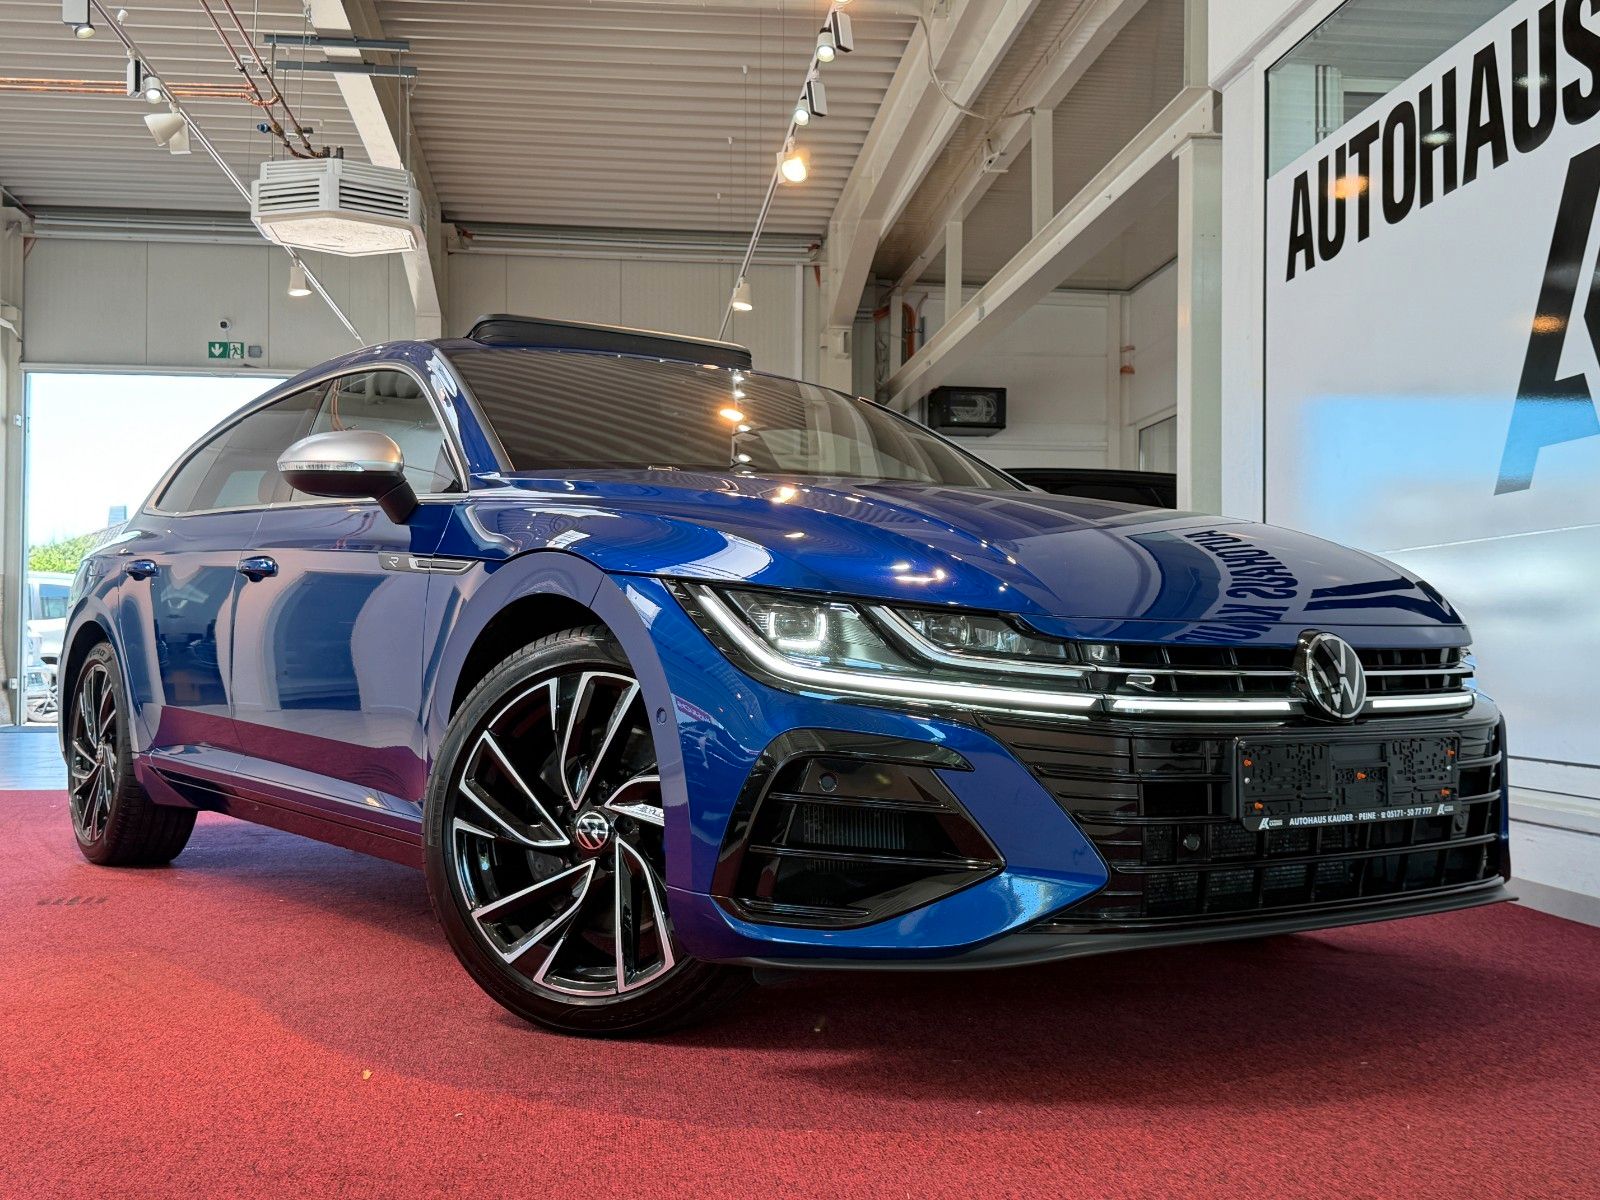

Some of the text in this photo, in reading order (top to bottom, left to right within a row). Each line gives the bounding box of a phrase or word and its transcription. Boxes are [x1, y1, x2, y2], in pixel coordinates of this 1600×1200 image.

[1286, 0, 1600, 282] AUTOHAUS
[389, 556, 399, 568] R
[1126, 674, 1157, 692] R
[1306, 632, 1367, 719] VW
[1289, 815, 1327, 826] AUTOHAUS
[1327, 813, 1354, 824] KAUDER
[1358, 811, 1377, 821] PEINE
